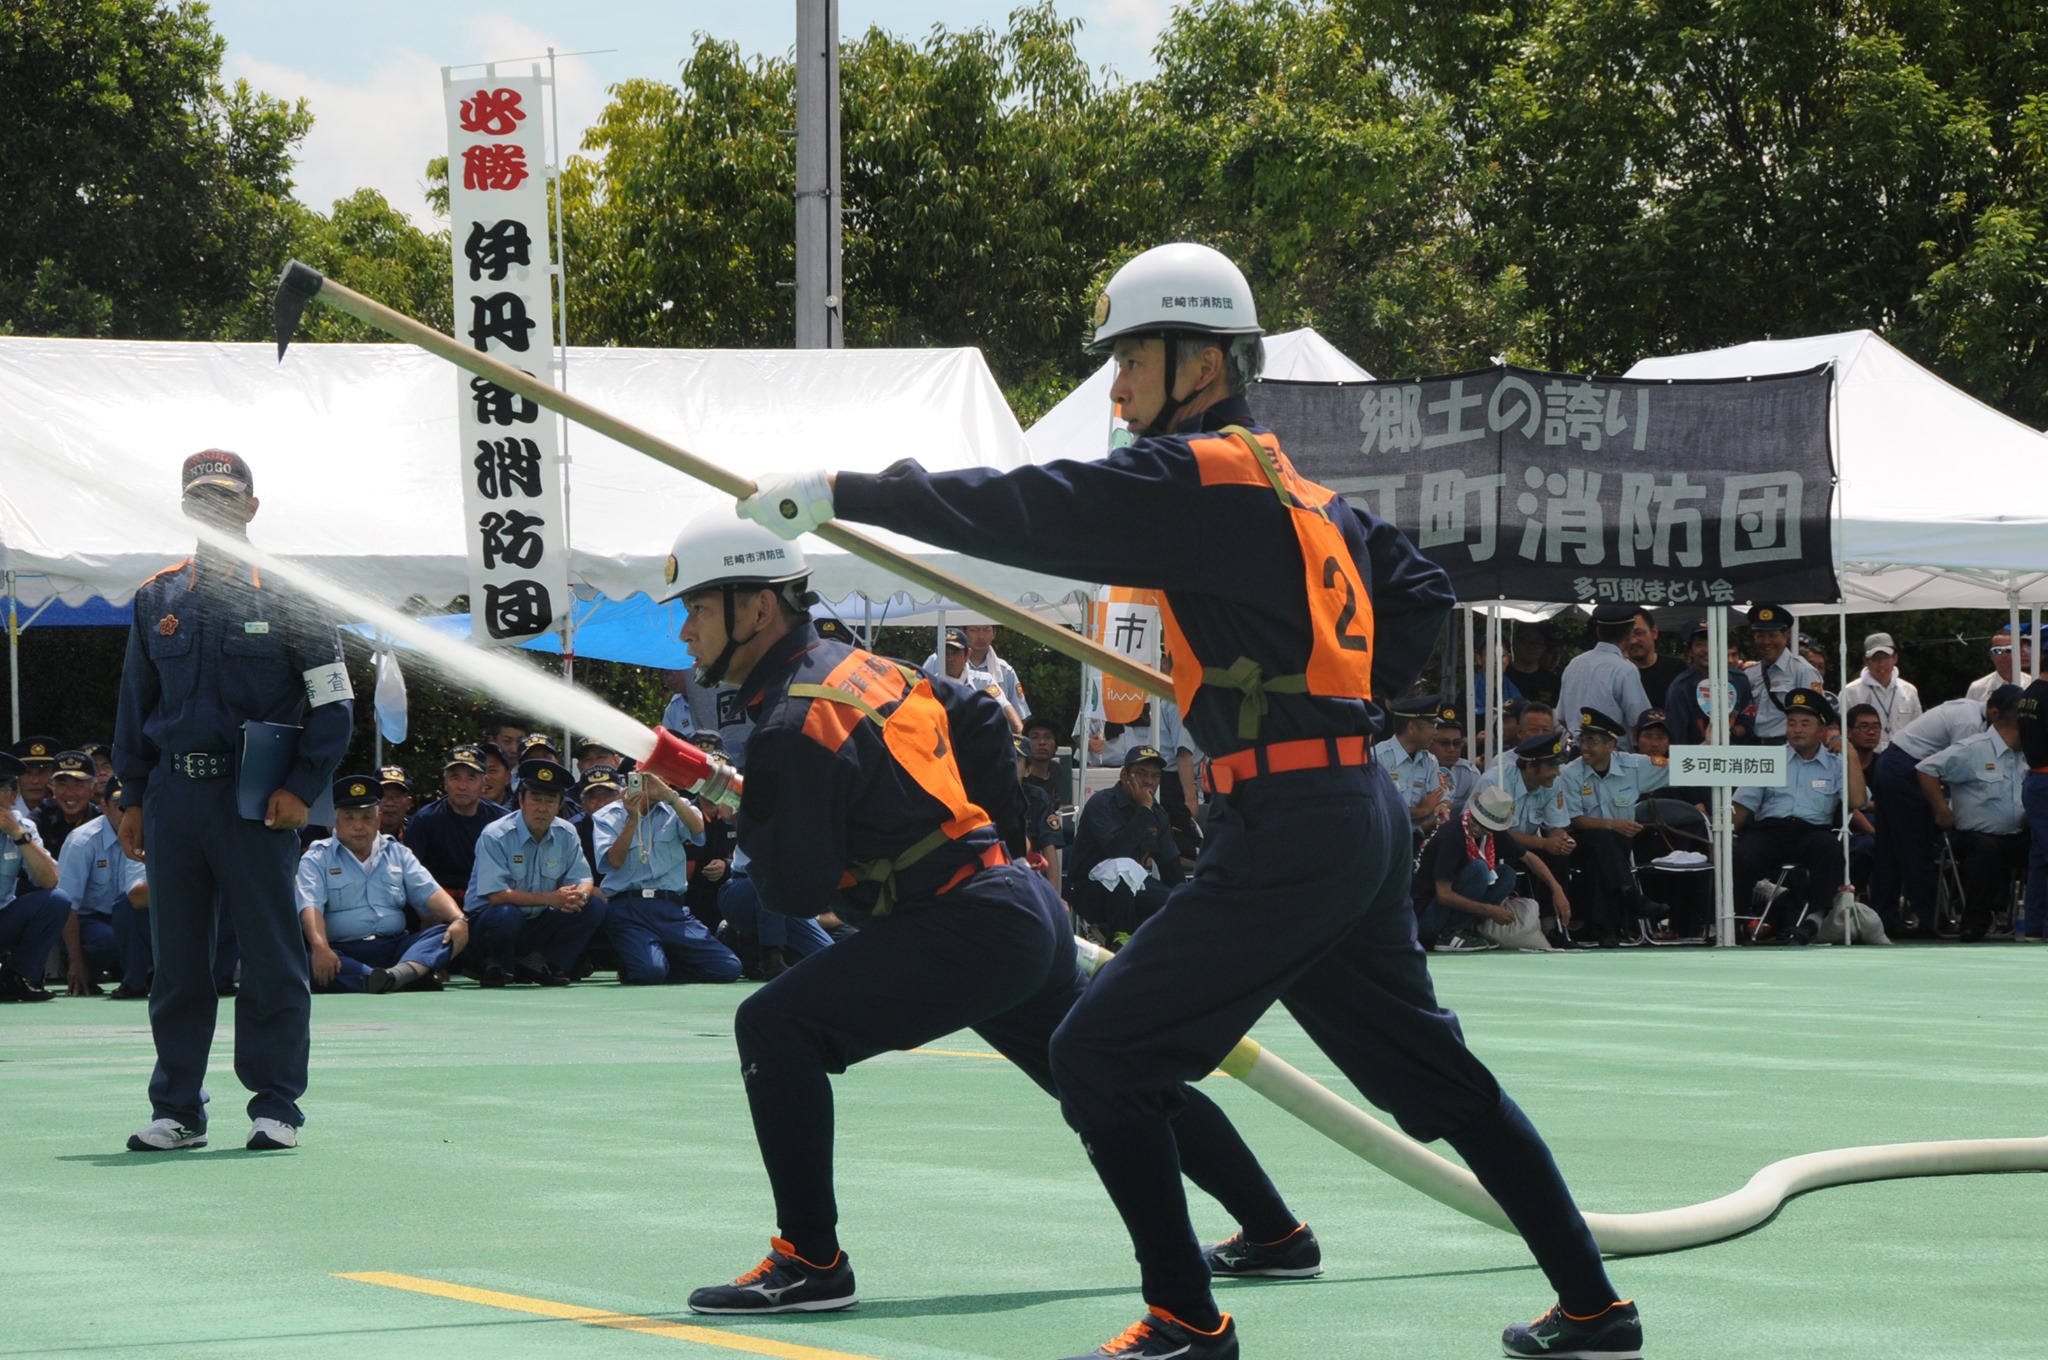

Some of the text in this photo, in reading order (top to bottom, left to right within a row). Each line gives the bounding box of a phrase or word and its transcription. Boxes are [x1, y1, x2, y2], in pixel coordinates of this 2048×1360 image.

[1161, 296, 1233, 309] 尼崎市消防団
[1359, 376, 1649, 455] 郷土の誇り
[190, 462, 232, 478] HYOGO
[723, 549, 785, 566] 尼崎市消防団
[1573, 576, 1735, 602] 多可郡まとい会
[1323, 556, 1368, 652] 2
[1115, 612, 1147, 654] 市
[1681, 757, 1775, 774] 多可町消防団
